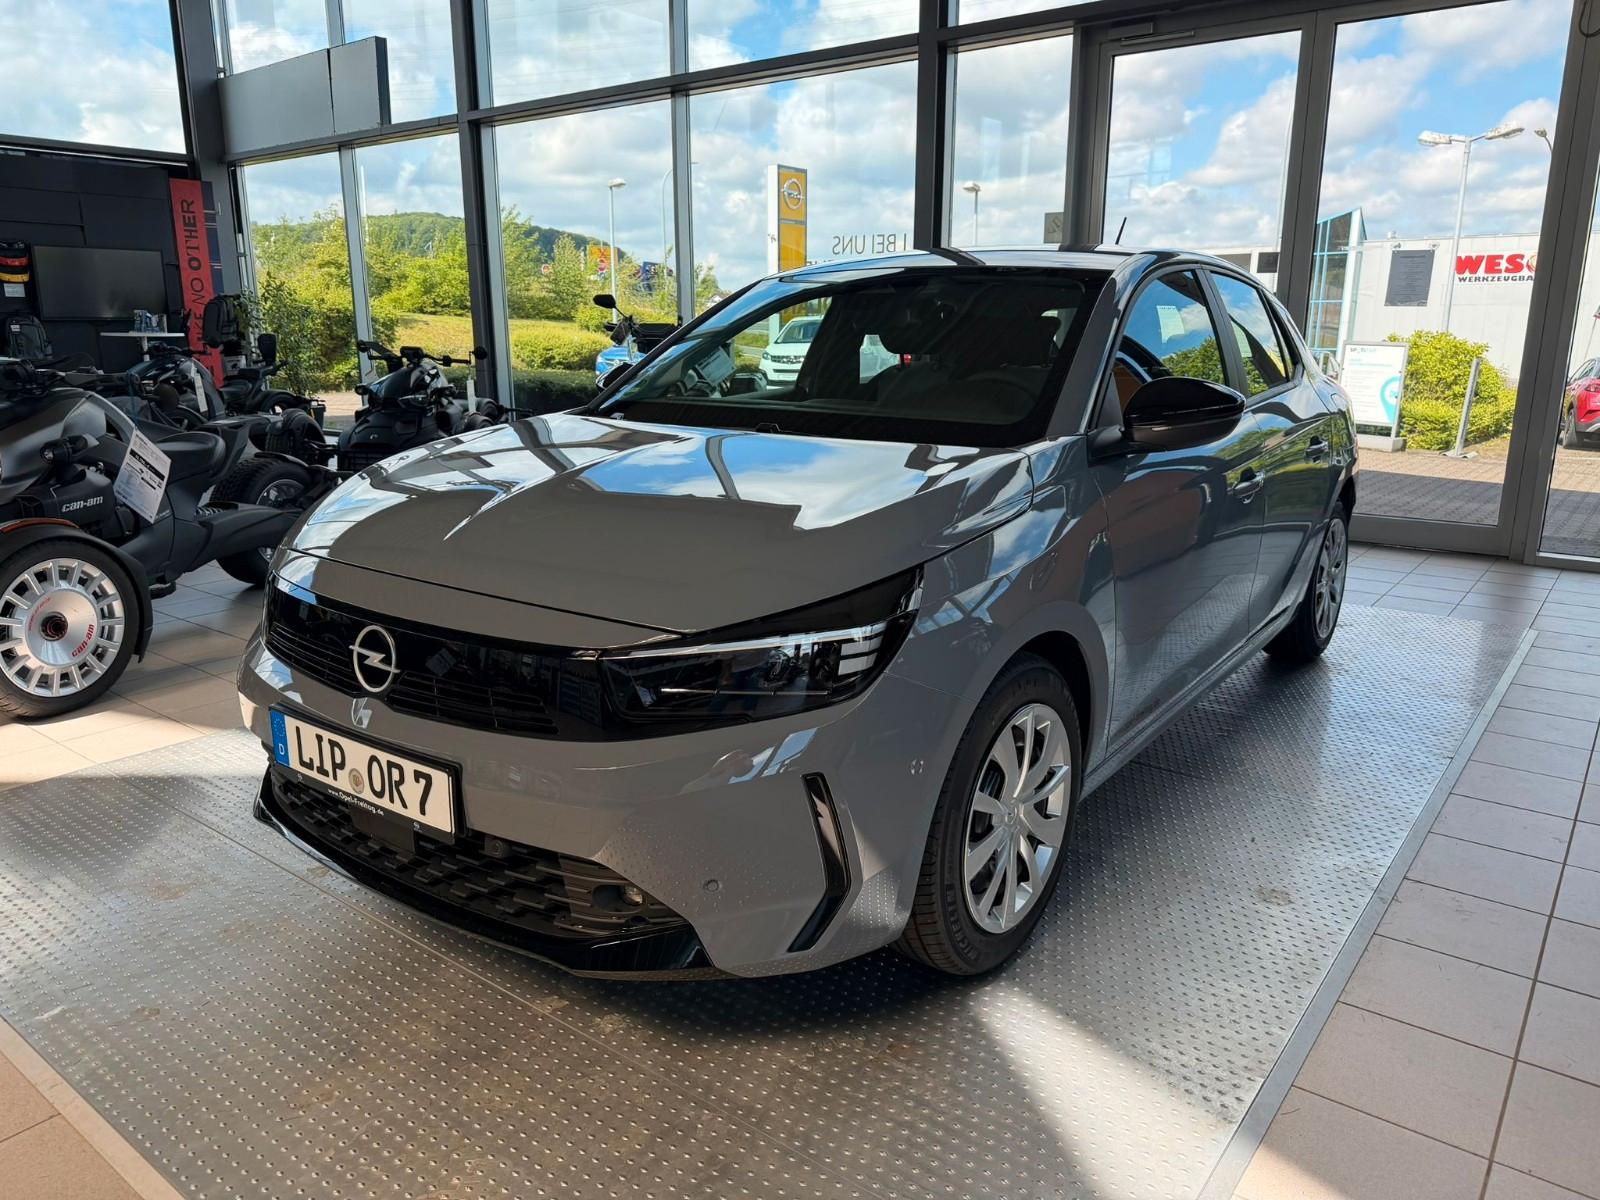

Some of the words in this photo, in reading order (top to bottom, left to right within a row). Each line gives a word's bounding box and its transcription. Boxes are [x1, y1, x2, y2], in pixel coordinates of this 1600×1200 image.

[181, 199, 203, 271] OTHER
[190, 276, 207, 306] NO
[61, 496, 104, 513] can-am
[71, 623, 95, 657] can-am
[278, 743, 285, 755] D
[295, 725, 347, 782] LIP
[367, 754, 409, 810] OR
[413, 769, 433, 816] 7
